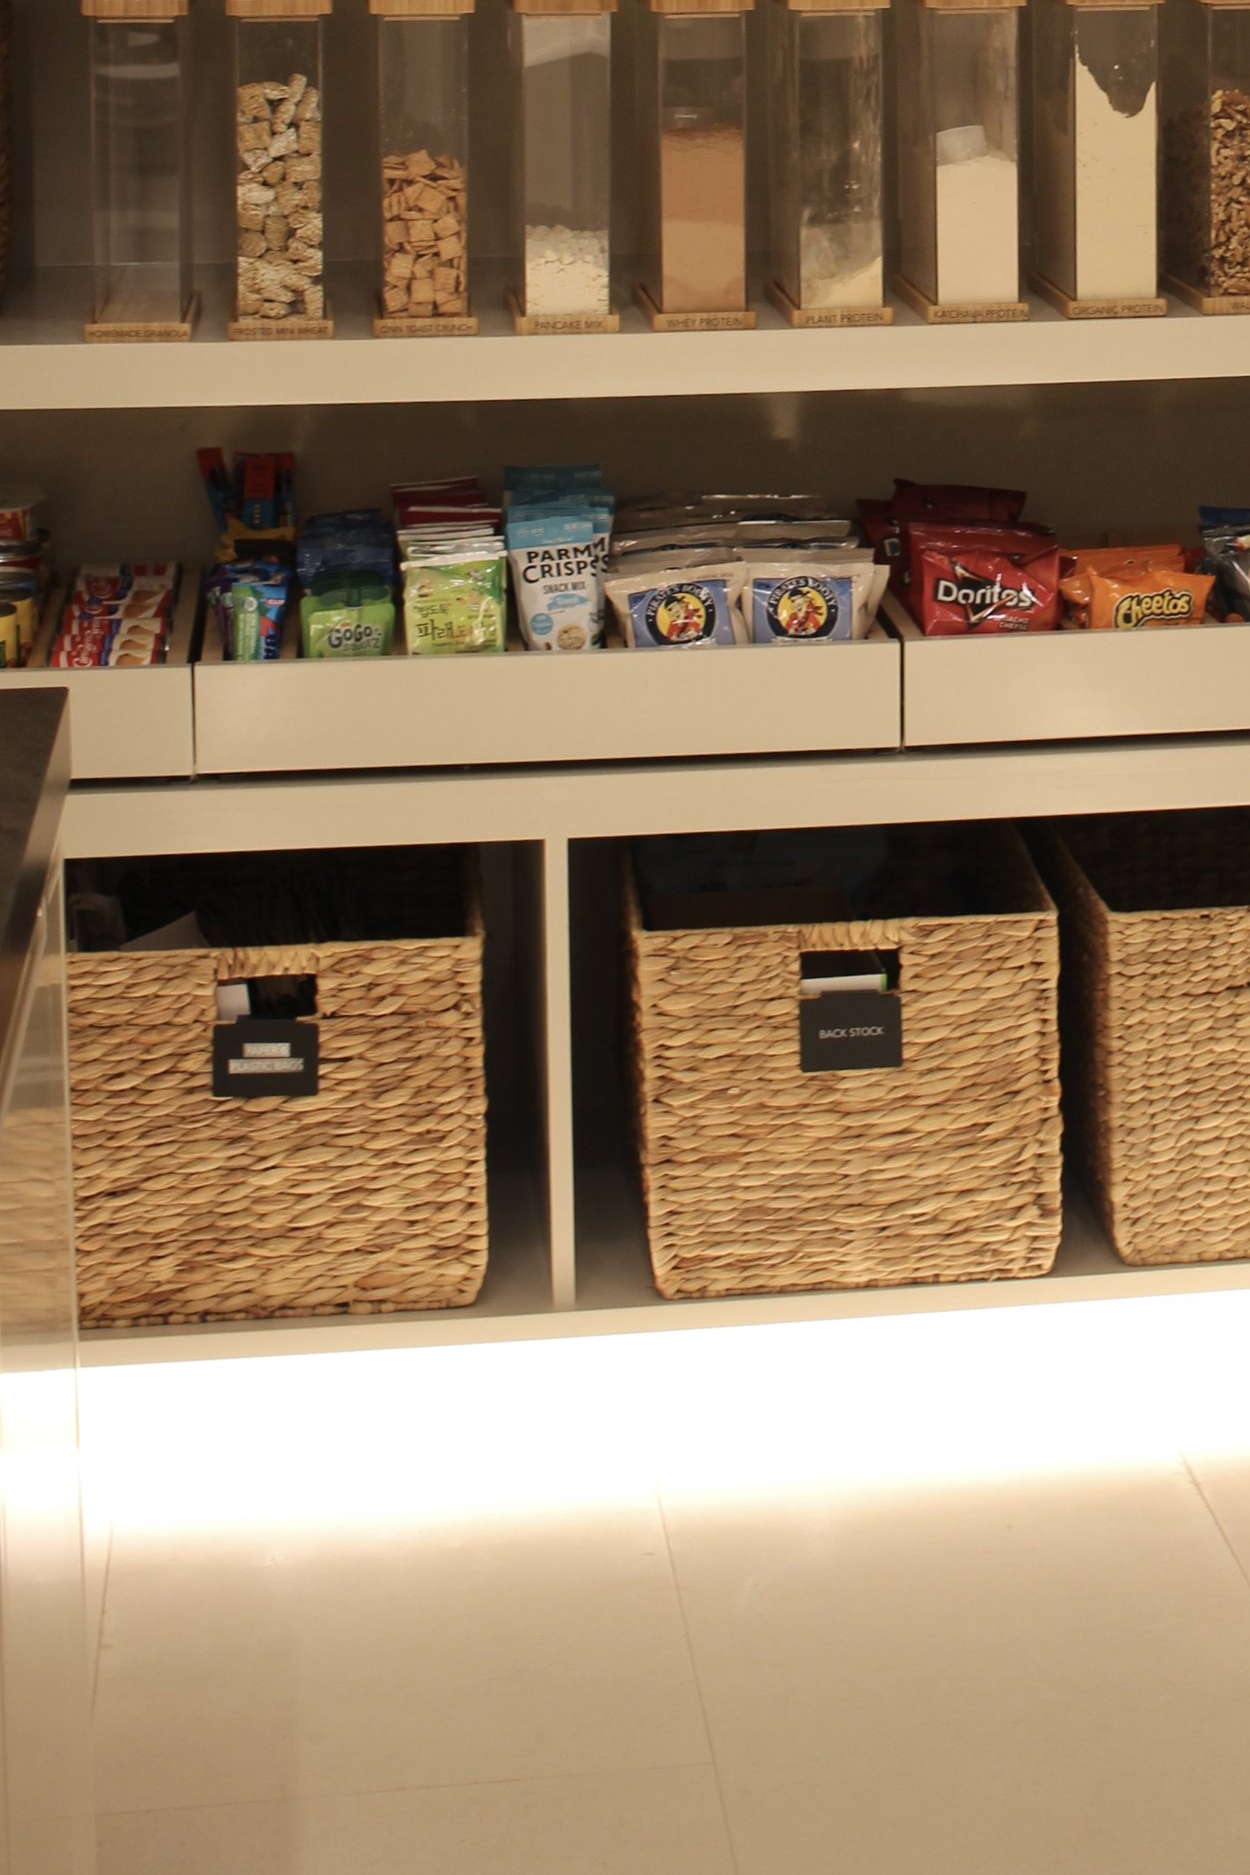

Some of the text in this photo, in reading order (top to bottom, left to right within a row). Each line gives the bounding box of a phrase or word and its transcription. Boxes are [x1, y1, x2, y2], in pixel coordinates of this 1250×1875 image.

[1072, 304, 1164, 316] ORGANIC PROTEIN
[666, 317, 742, 328] WHEY PROTEIN
[806, 313, 884, 324] PLANT PROTEIN
[406, 325, 434, 334] TOAST
[437, 324, 472, 334] CRUNCH
[534, 321, 604, 330] PANCAKE MIX
[88, 329, 188, 339] HOMEMADE GRANOLA
[233, 326, 329, 337] FROSTED MINI WHEAT
[526, 544, 593, 564] PARM
[523, 554, 598, 584] CRISPS
[936, 579, 1033, 607] Doritos
[1114, 589, 1194, 628] Cheetos
[819, 1026, 884, 1039] BACK STOCK
